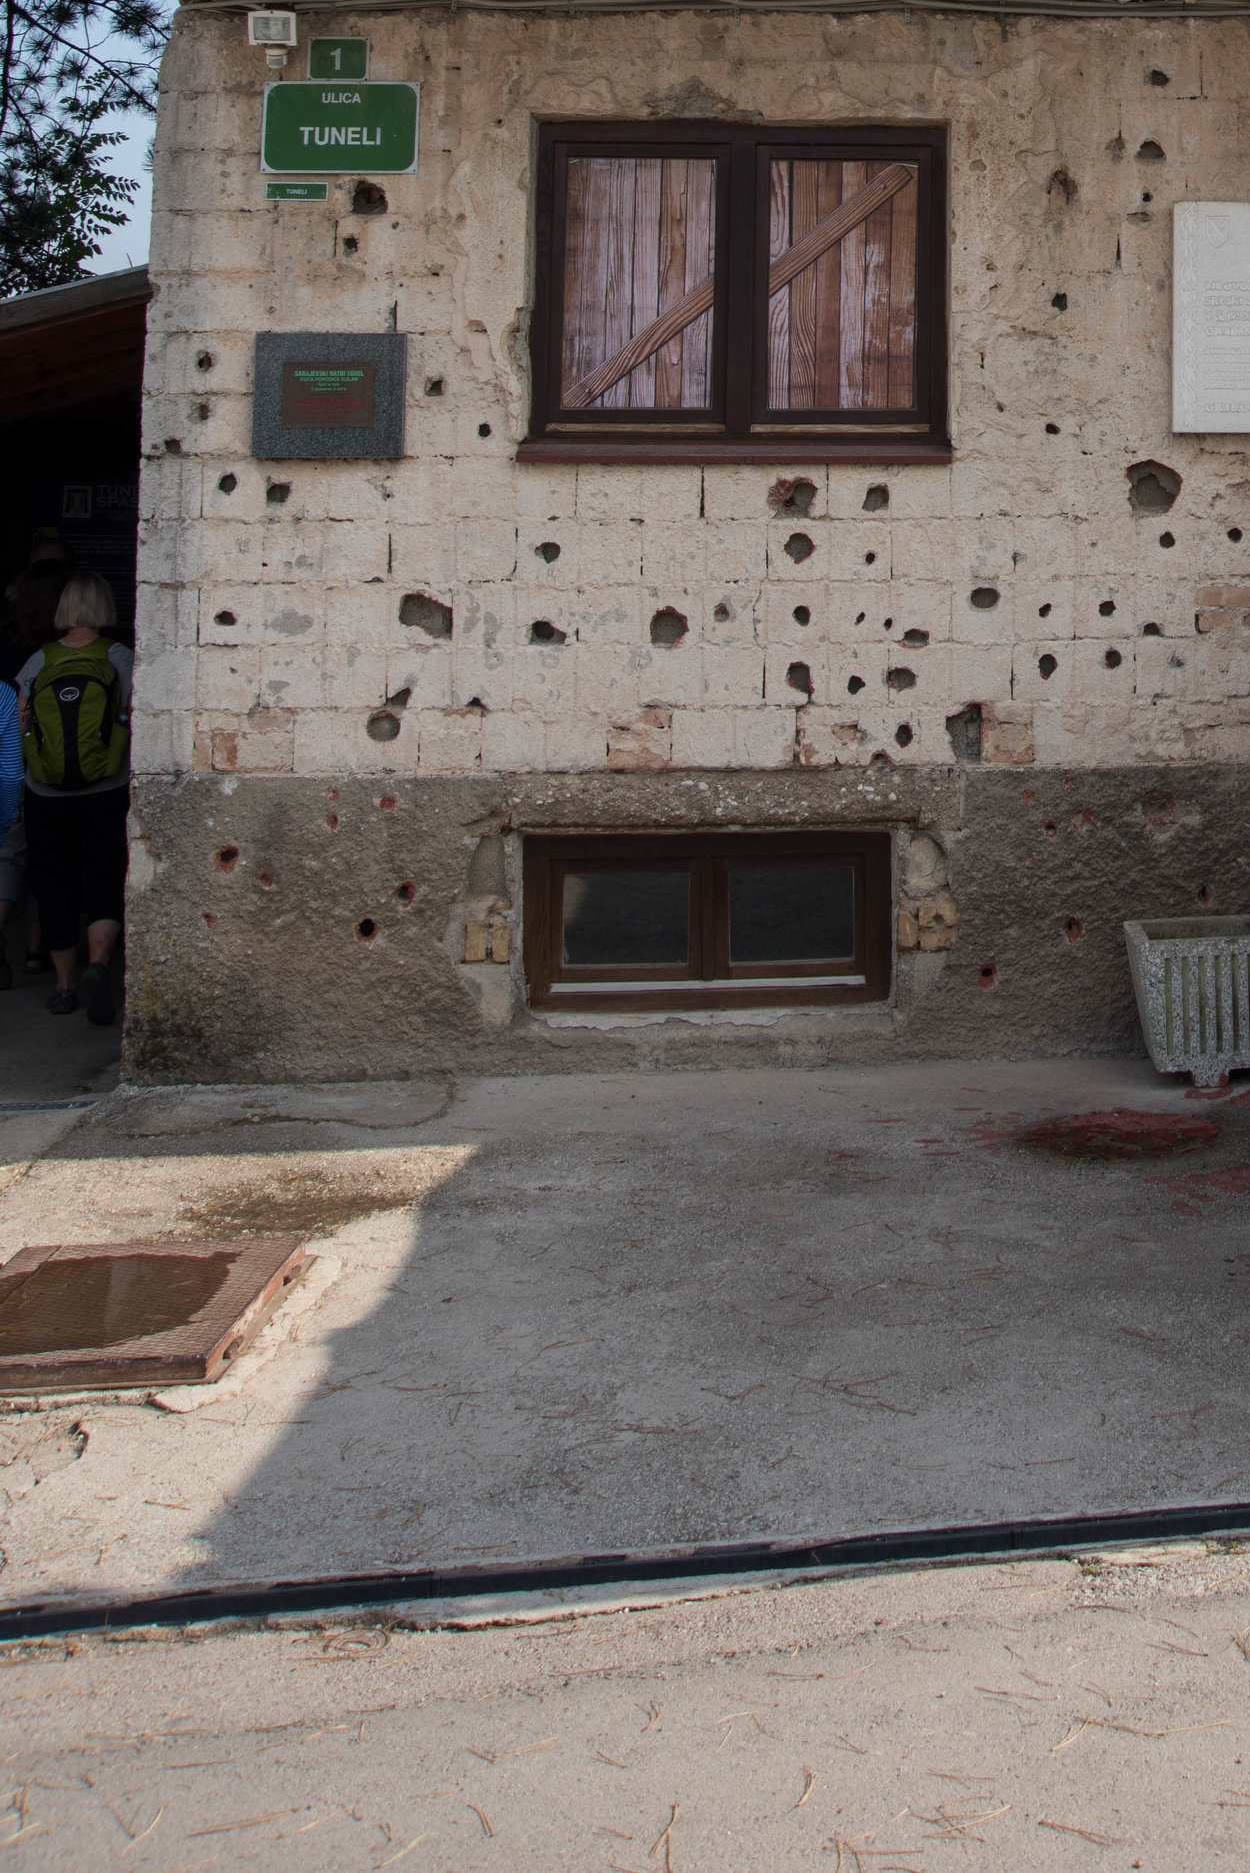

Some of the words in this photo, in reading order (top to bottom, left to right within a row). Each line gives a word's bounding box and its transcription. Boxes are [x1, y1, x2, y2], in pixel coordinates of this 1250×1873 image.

[330, 47, 342, 71] 1
[322, 92, 362, 104] ULICA
[300, 126, 382, 146] TUNELI
